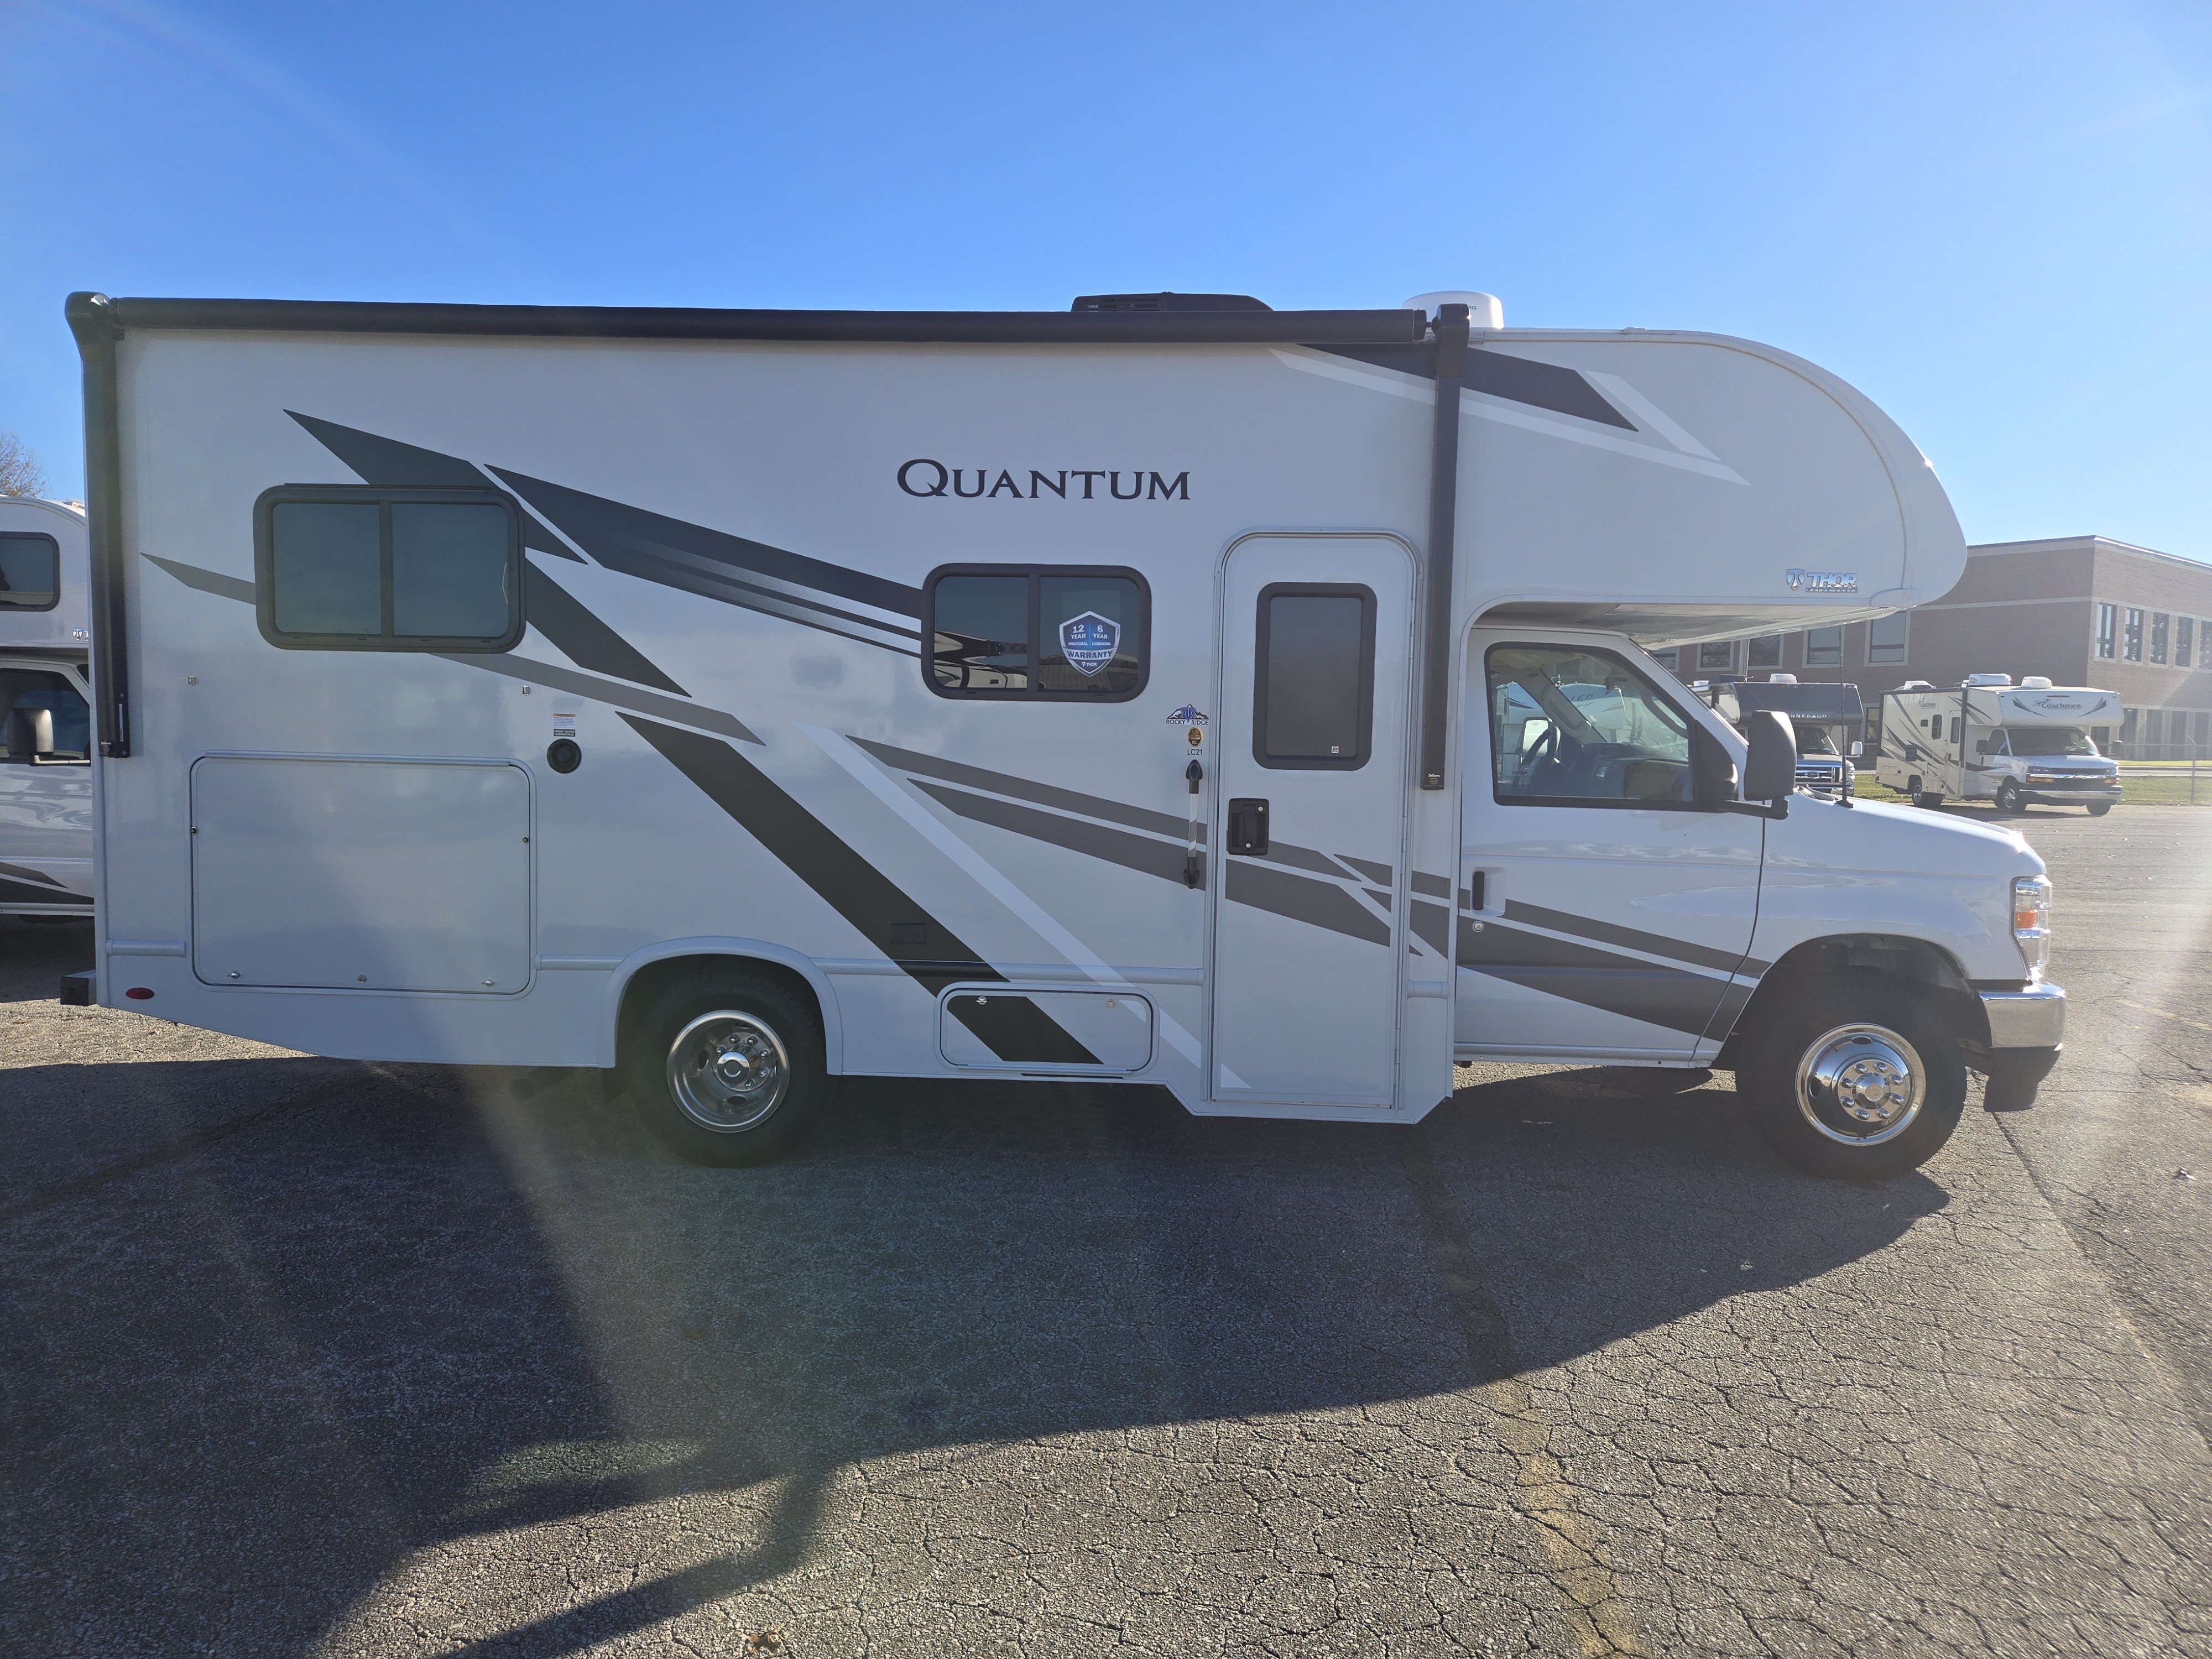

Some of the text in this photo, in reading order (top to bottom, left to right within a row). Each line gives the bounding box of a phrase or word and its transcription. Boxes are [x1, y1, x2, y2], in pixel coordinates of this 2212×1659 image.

[897, 458, 1191, 500] QUANTUM
[1807, 572, 1858, 588] THOR
[1072, 624, 1084, 633] 12
[1097, 624, 1103, 633] 6
[1067, 650, 1113, 659] WARRANTY
